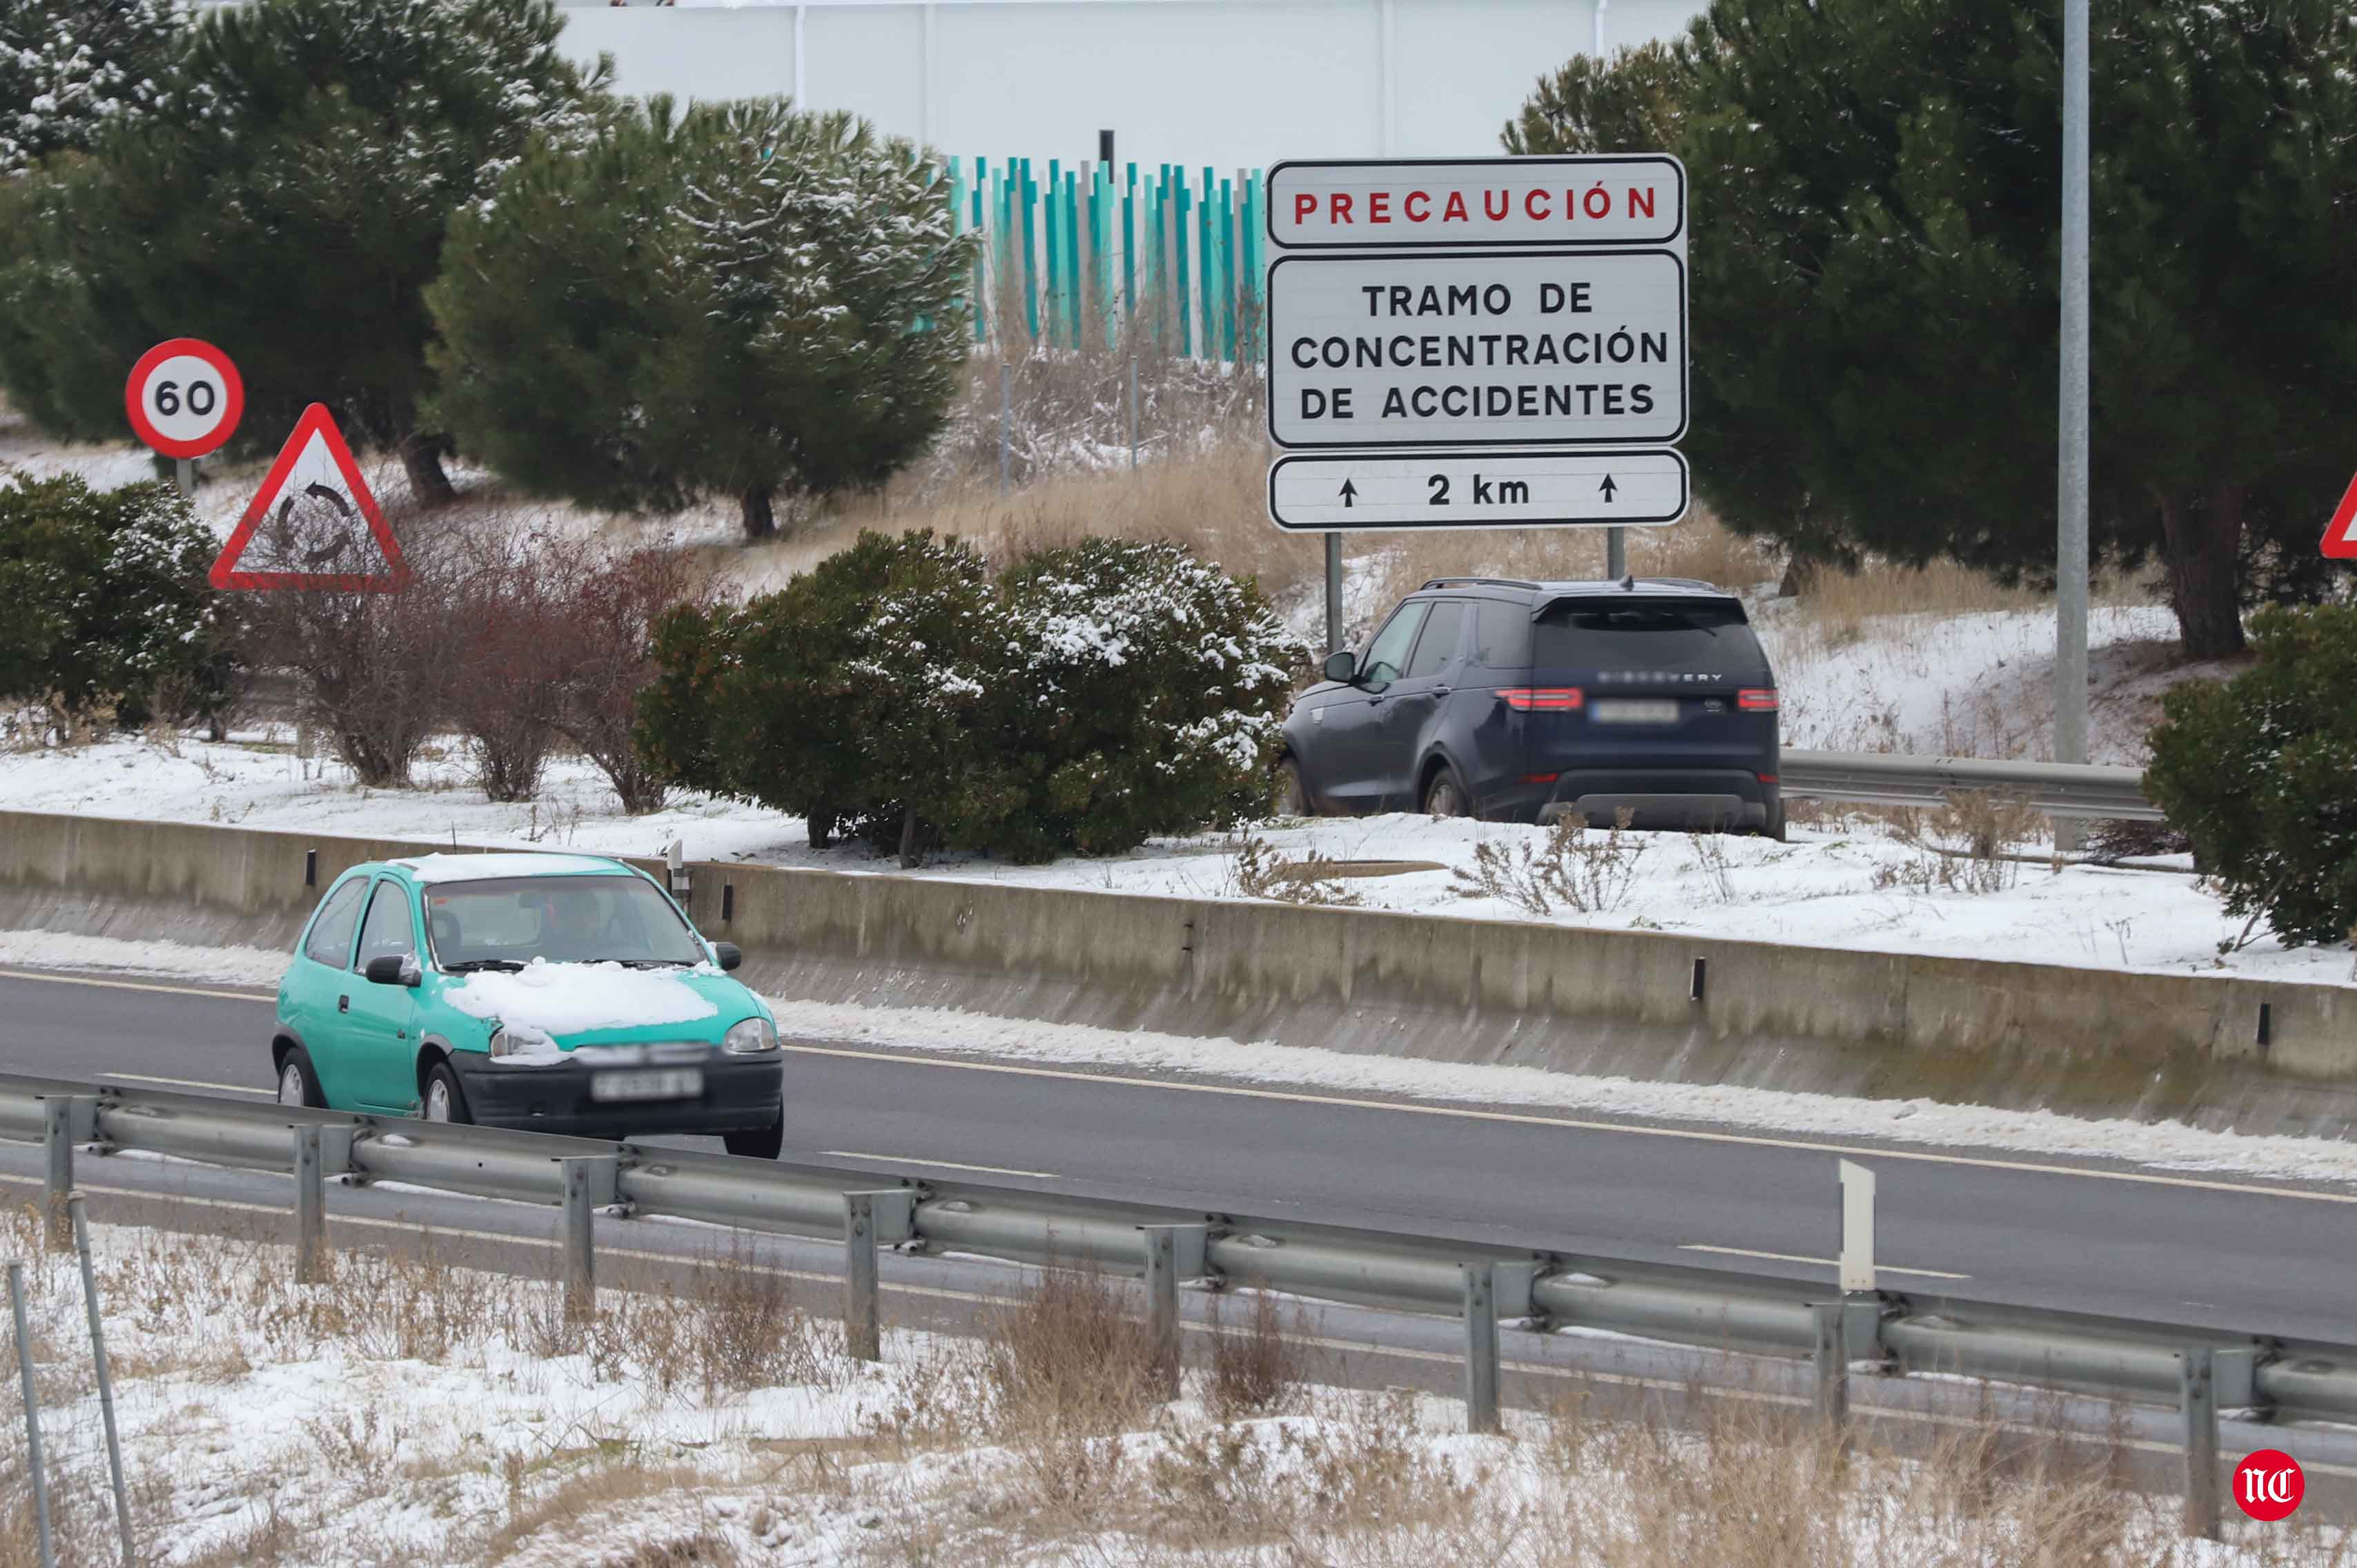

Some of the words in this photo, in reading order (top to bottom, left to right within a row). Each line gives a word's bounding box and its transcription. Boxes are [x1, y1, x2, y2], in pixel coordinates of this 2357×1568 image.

[1295, 182, 1654, 224] PRECAUCIÓN
[1362, 284, 1512, 316] TRAMO
[1540, 282, 1592, 313] DE
[1291, 325, 1667, 368] CONCENTRACIÓN
[155, 380, 215, 415] 60
[1301, 388, 1353, 419] DE
[1381, 384, 1654, 418] ACCIDENTES
[1428, 474, 1450, 505] 2
[1473, 474, 1529, 504] km
